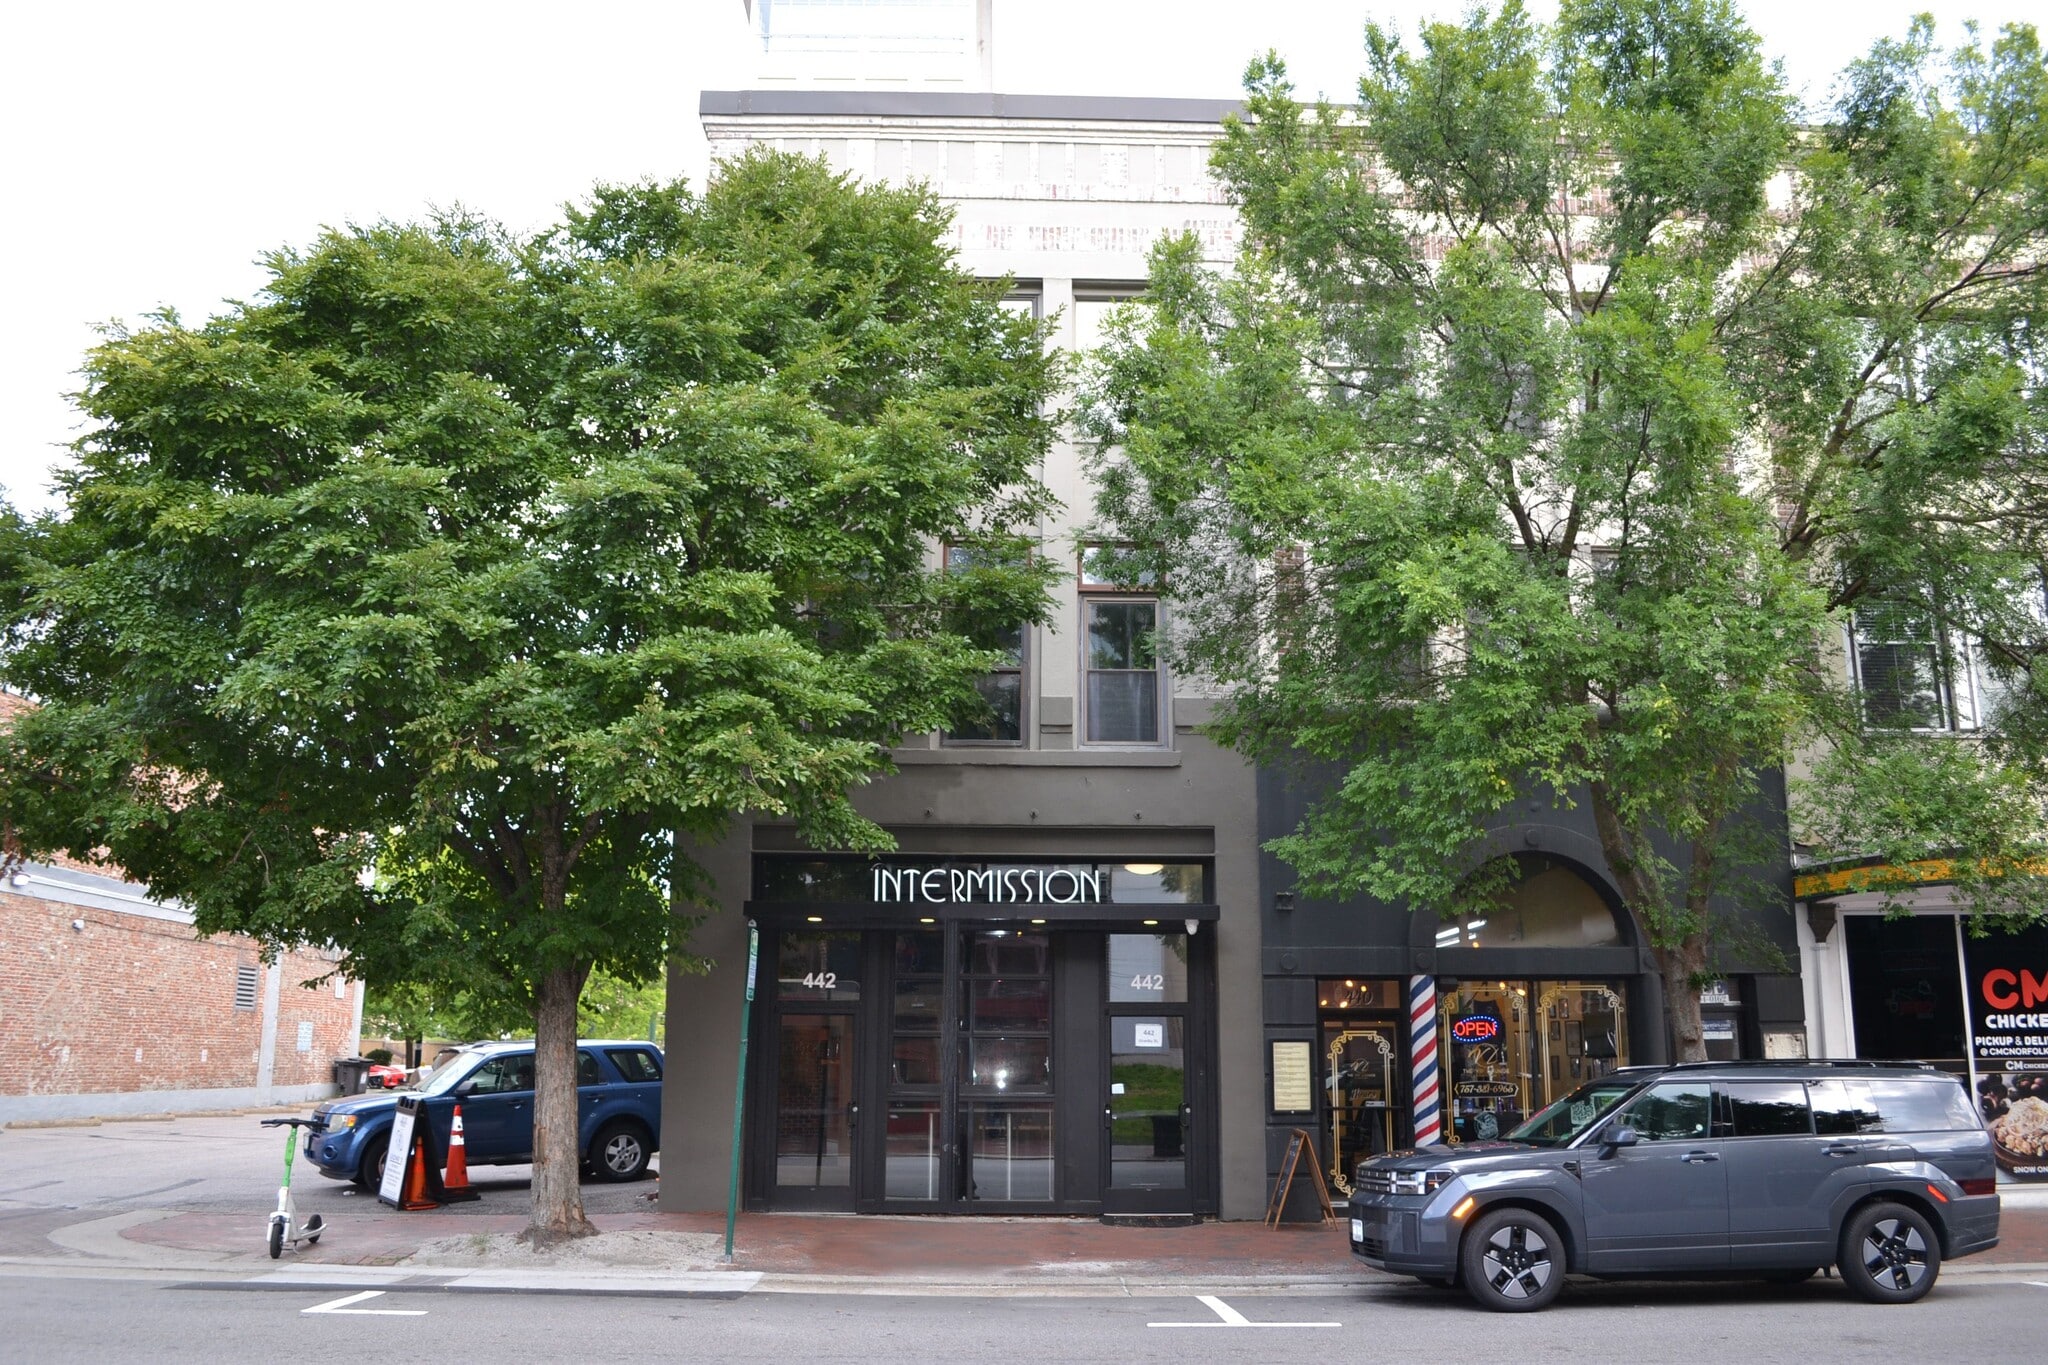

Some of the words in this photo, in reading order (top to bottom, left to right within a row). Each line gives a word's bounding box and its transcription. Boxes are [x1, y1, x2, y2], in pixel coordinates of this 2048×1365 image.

[874, 868, 1100, 903] INTERMISSION
[803, 972, 837, 989] 442
[1131, 974, 1164, 990] 442
[1982, 968, 2048, 1009] CM
[1454, 1021, 1497, 1036] OPEN
[1975, 1036, 2013, 1046] PICKUP
[2014, 1036, 2023, 1046] &
[2024, 1036, 2048, 1046] DELI
[2005, 1060, 2023, 1070] CM
